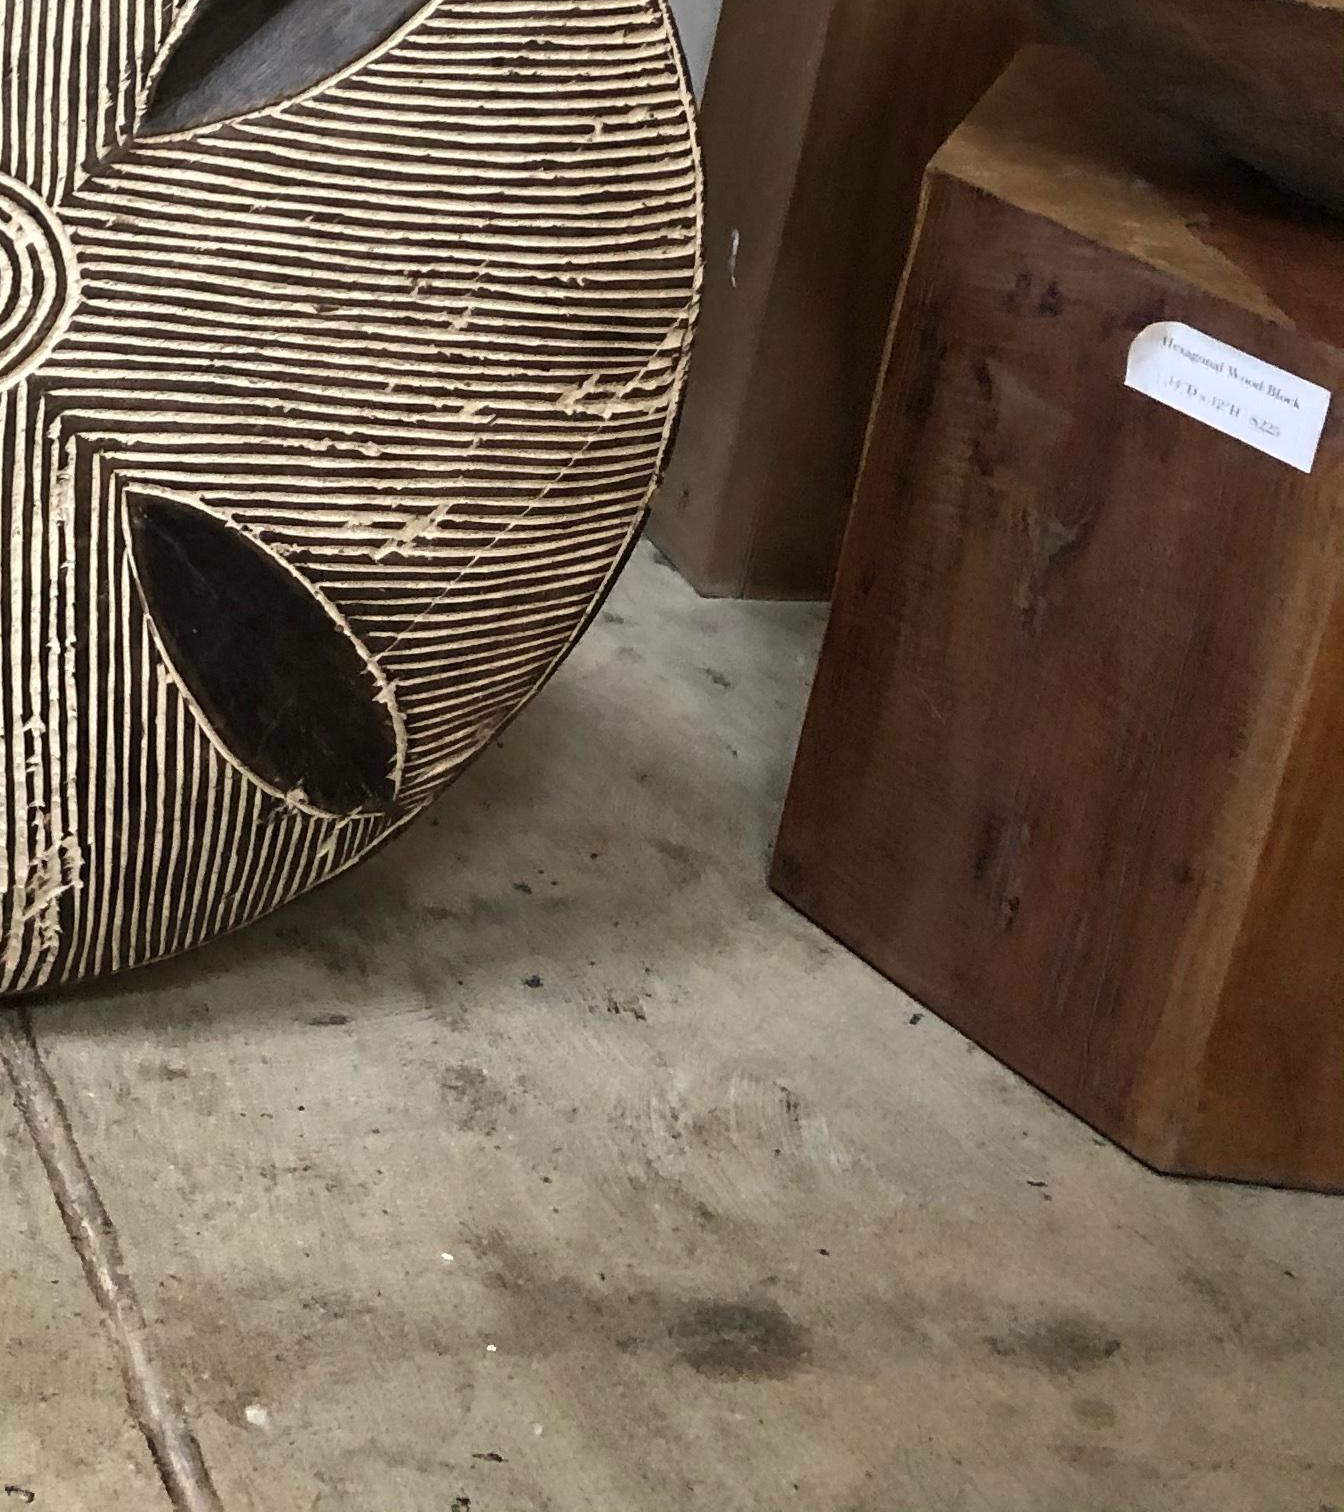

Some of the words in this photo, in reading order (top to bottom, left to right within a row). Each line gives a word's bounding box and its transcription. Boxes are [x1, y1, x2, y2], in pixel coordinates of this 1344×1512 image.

[1161, 336, 1224, 375] Hexagonal
[1228, 365, 1264, 392] Wood
[1266, 384, 1300, 410] Block
[1249, 416, 1281, 437] $225
